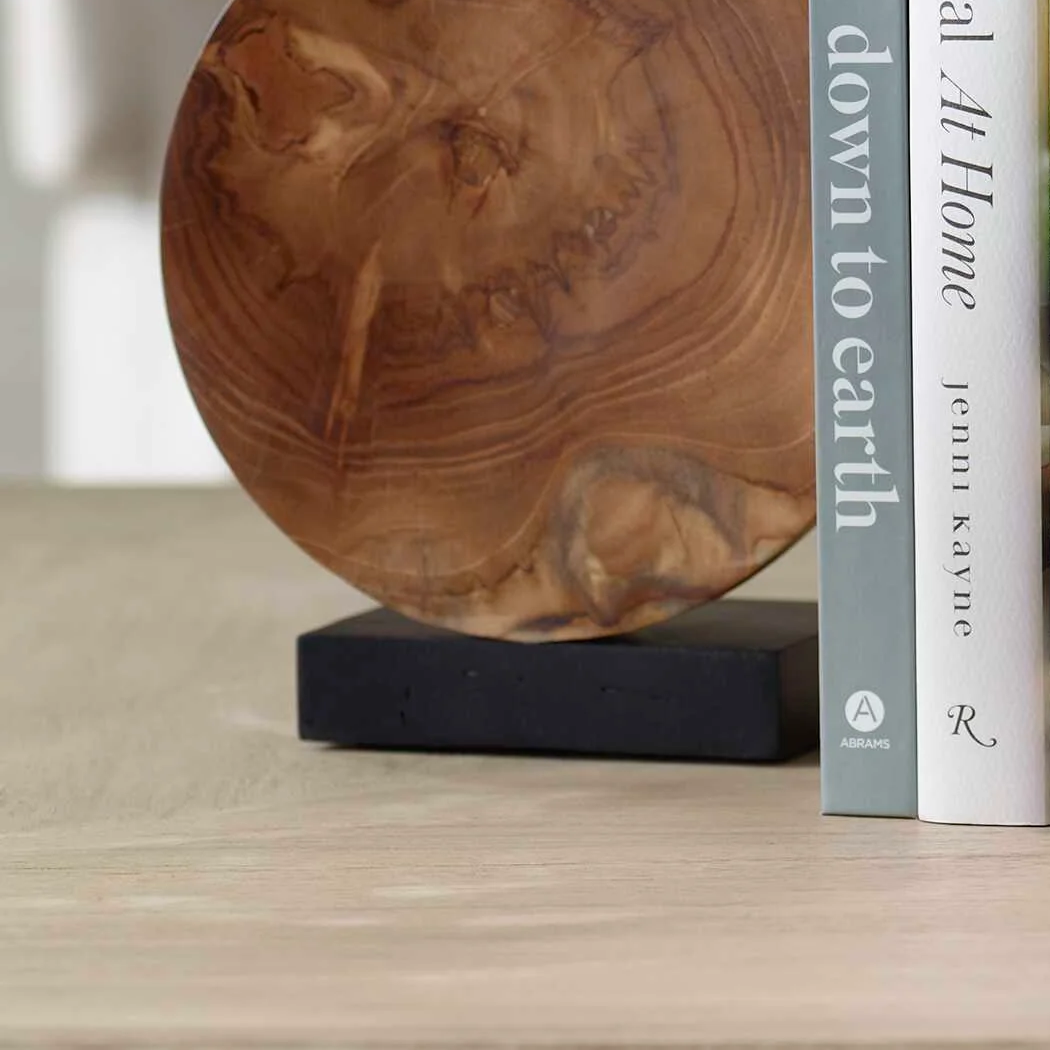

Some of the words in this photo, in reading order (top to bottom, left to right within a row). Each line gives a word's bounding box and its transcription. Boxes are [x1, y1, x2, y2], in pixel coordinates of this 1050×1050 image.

[826, 24, 895, 231] down
[940, 68, 993, 141] At
[940, 153, 994, 311] Home
[830, 246, 889, 319] to
[831, 336, 900, 533] earth
[839, 736, 891, 750] ABRAMS
[946, 703, 997, 749] R
